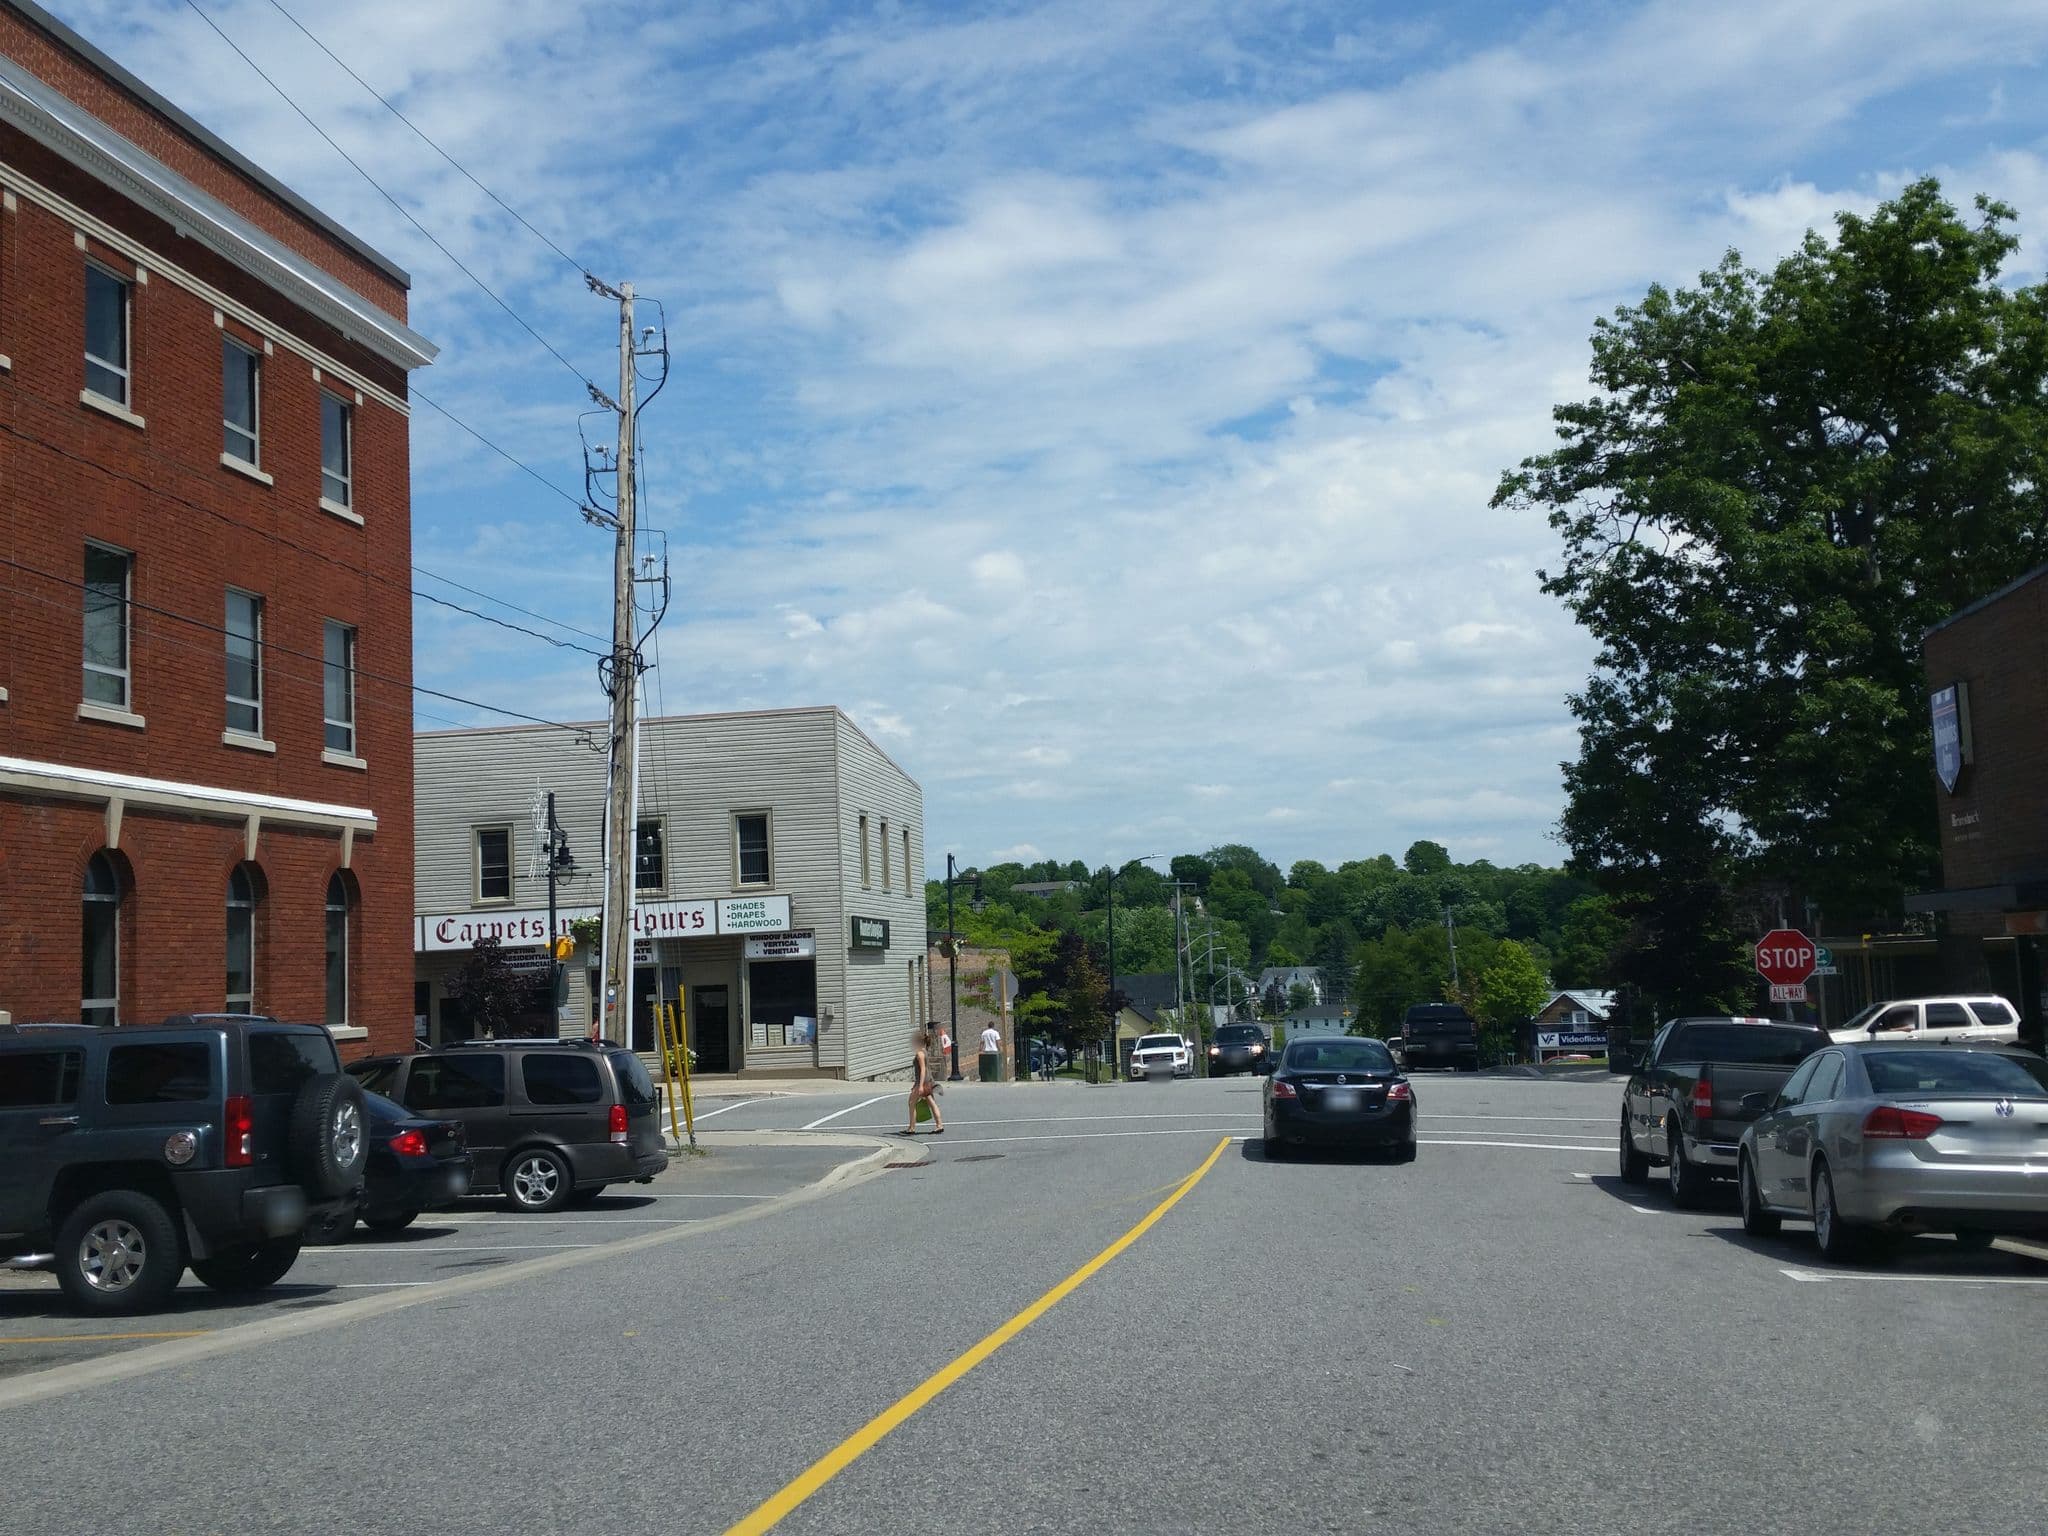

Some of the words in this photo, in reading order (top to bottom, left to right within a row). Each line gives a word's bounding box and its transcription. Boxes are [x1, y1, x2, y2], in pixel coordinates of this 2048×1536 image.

[731, 902, 765, 911] SHADES
[731, 911, 766, 920] DRAPES
[731, 919, 782, 928] HARDWOOD
[763, 940, 799, 948] VERTICAL
[763, 947, 800, 955] VENETIAN
[1759, 947, 1811, 969] STOP
[509, 960, 551, 969] OMMERCIAL
[1772, 985, 1804, 1000] ALL-WAY
[1561, 1035, 1607, 1044] Videoflicks
